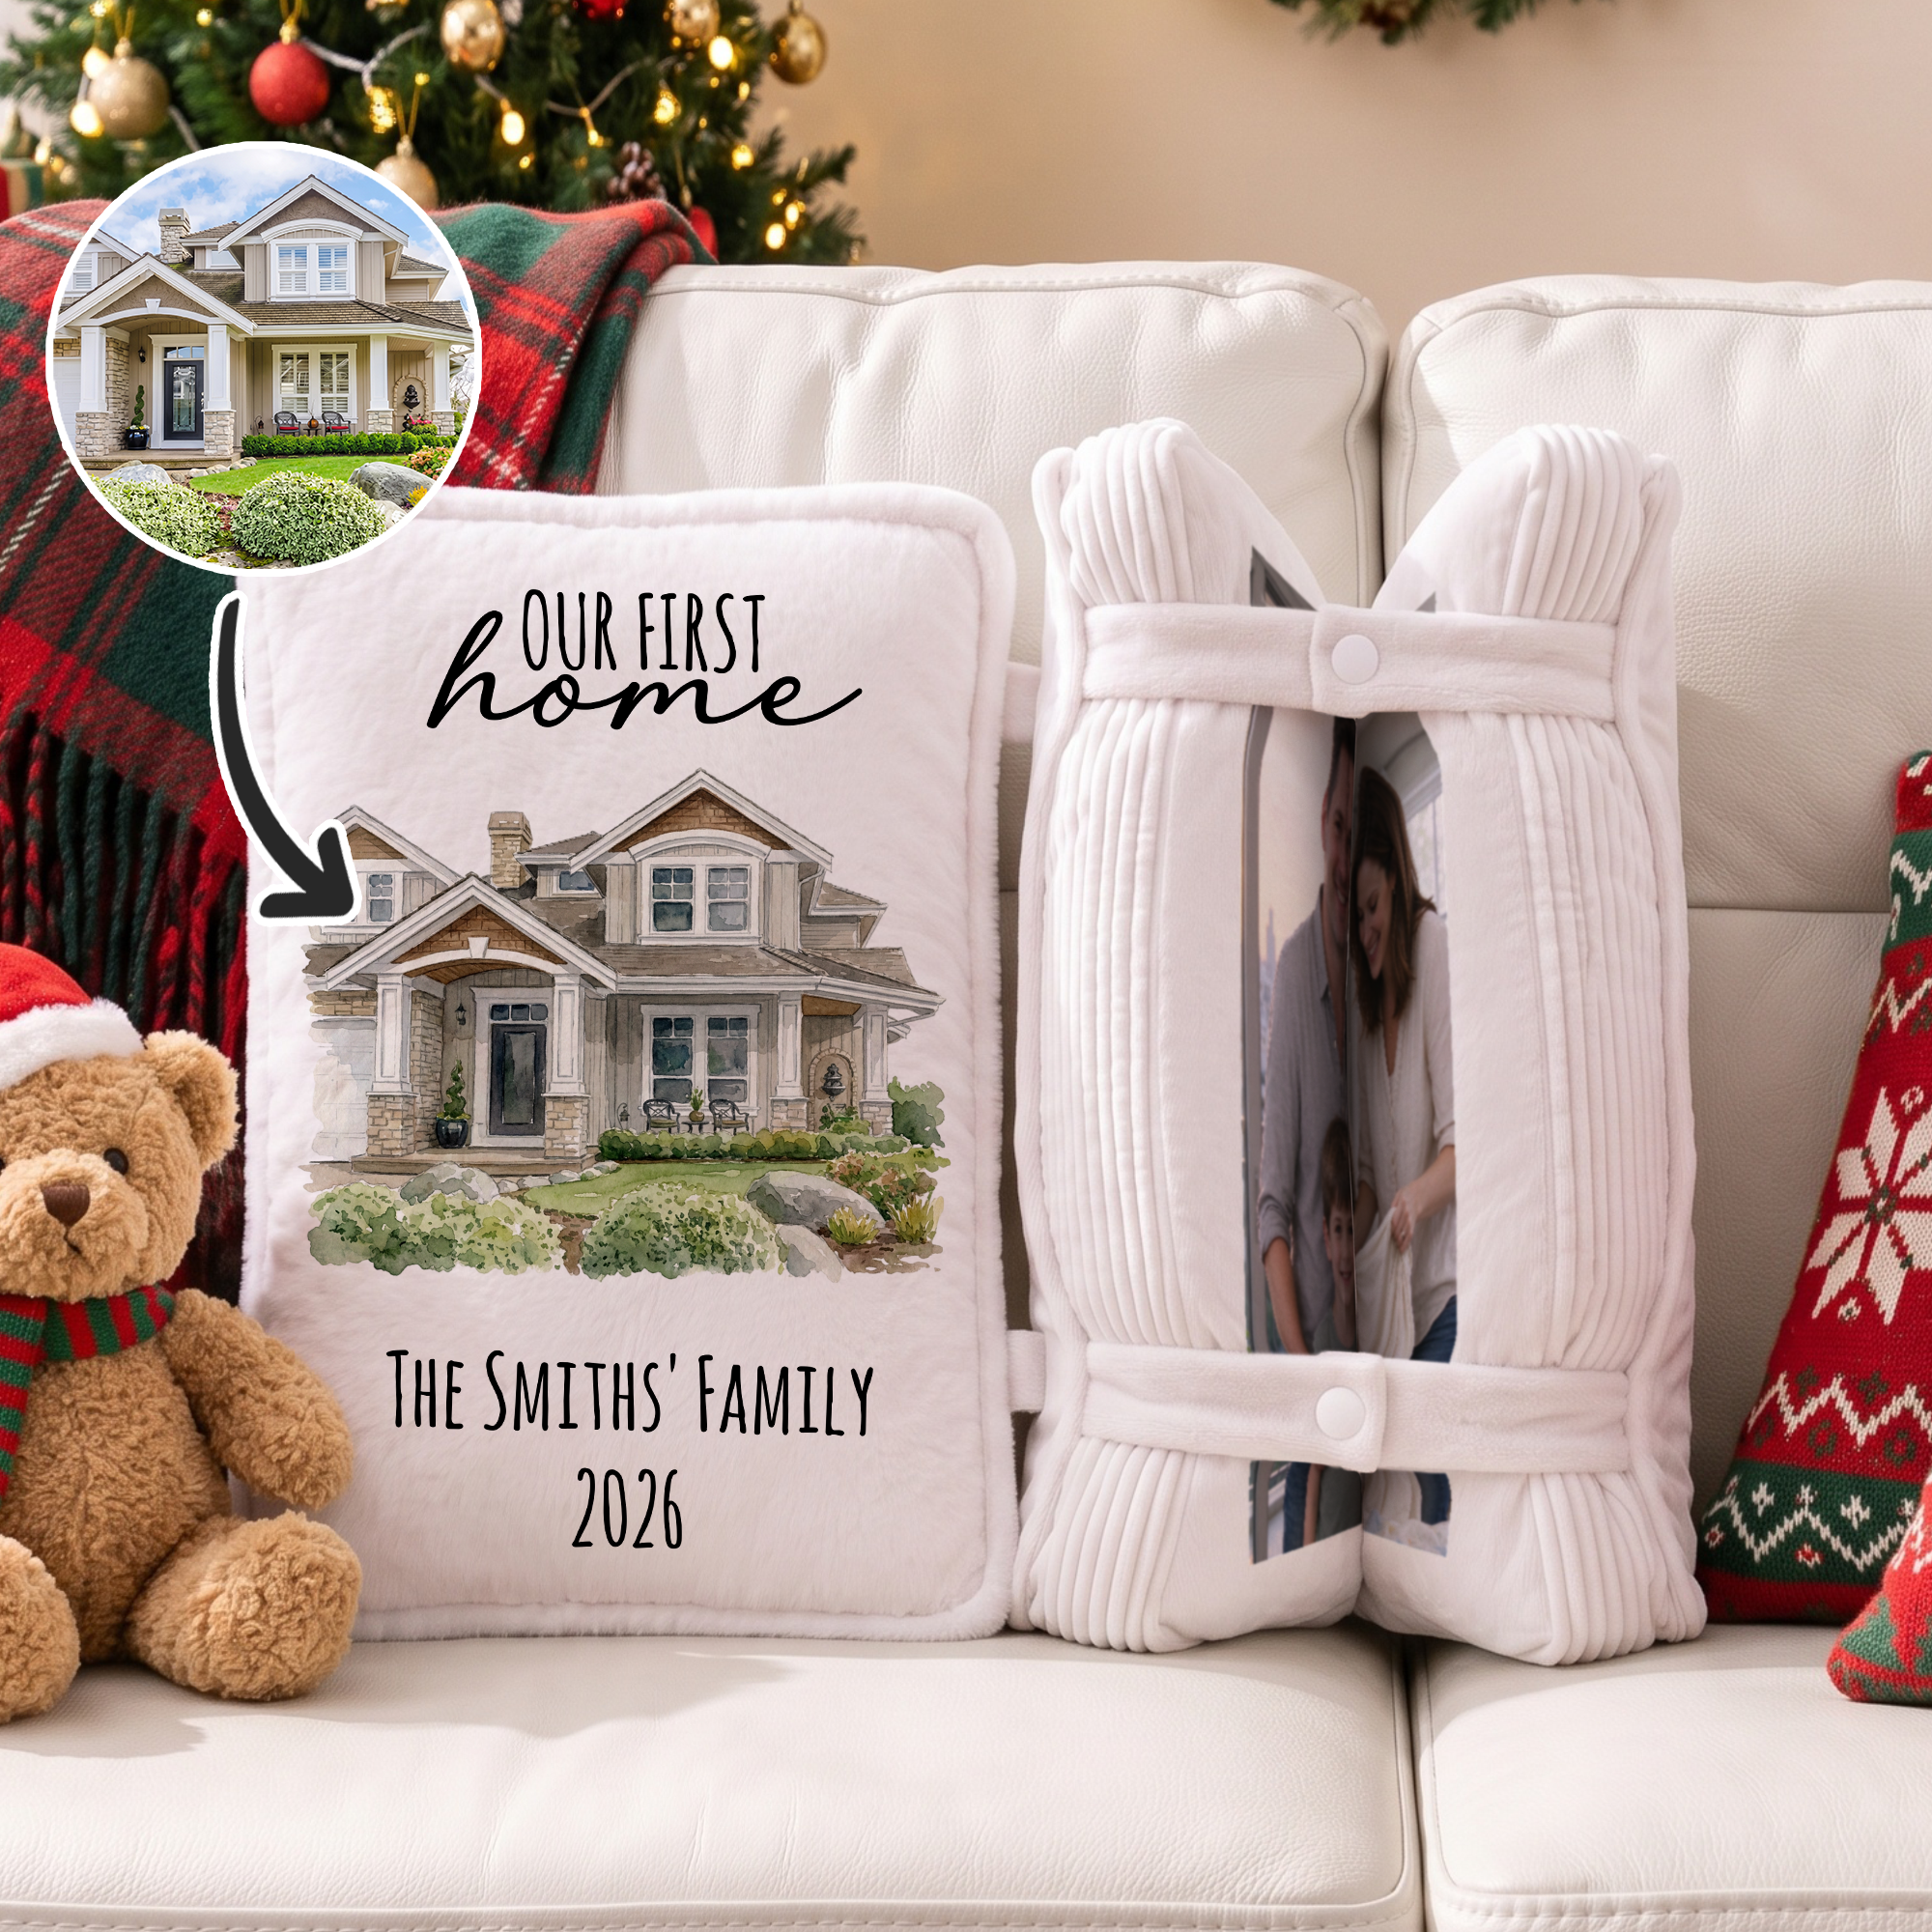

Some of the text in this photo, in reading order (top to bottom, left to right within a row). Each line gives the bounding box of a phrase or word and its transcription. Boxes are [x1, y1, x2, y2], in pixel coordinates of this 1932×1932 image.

[426, 610, 863, 730] home
[523, 589, 766, 674] OUR FIRST
[385, 1349, 464, 1430] THE
[697, 1353, 874, 1437] FAMILY
[571, 1466, 683, 1549] 2026
